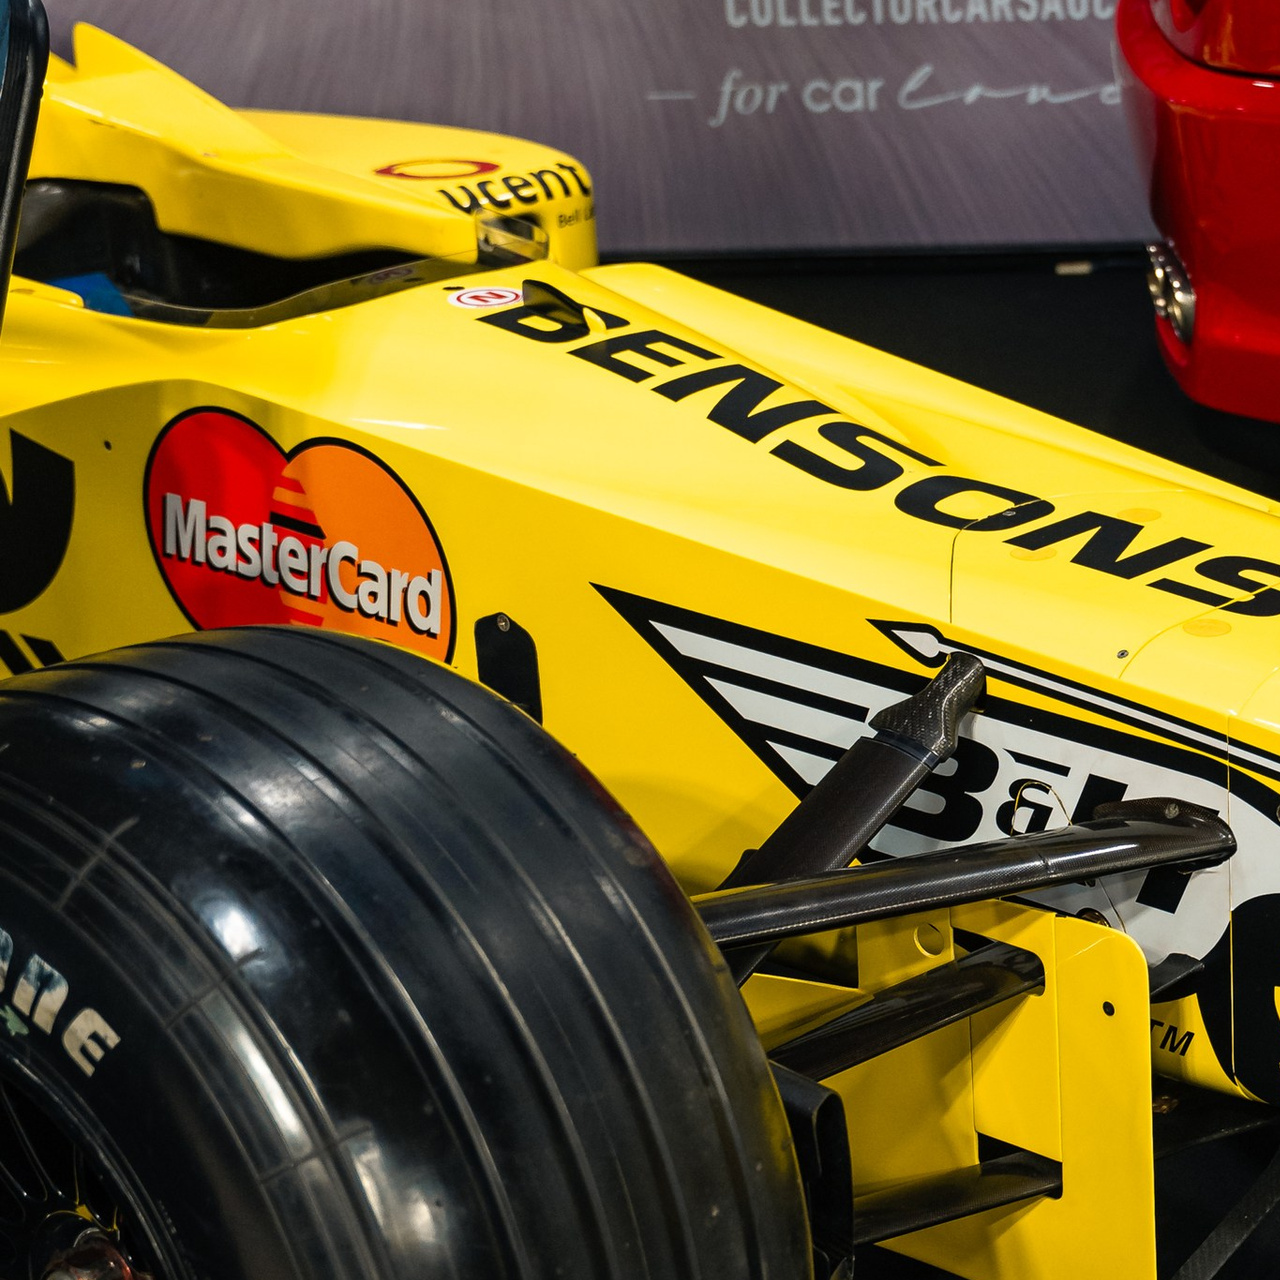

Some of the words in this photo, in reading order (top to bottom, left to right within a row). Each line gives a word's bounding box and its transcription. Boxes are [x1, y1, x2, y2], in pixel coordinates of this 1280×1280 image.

[708, 68, 789, 128] for
[802, 78, 886, 114] car
[162, 492, 443, 637] MasterCard
